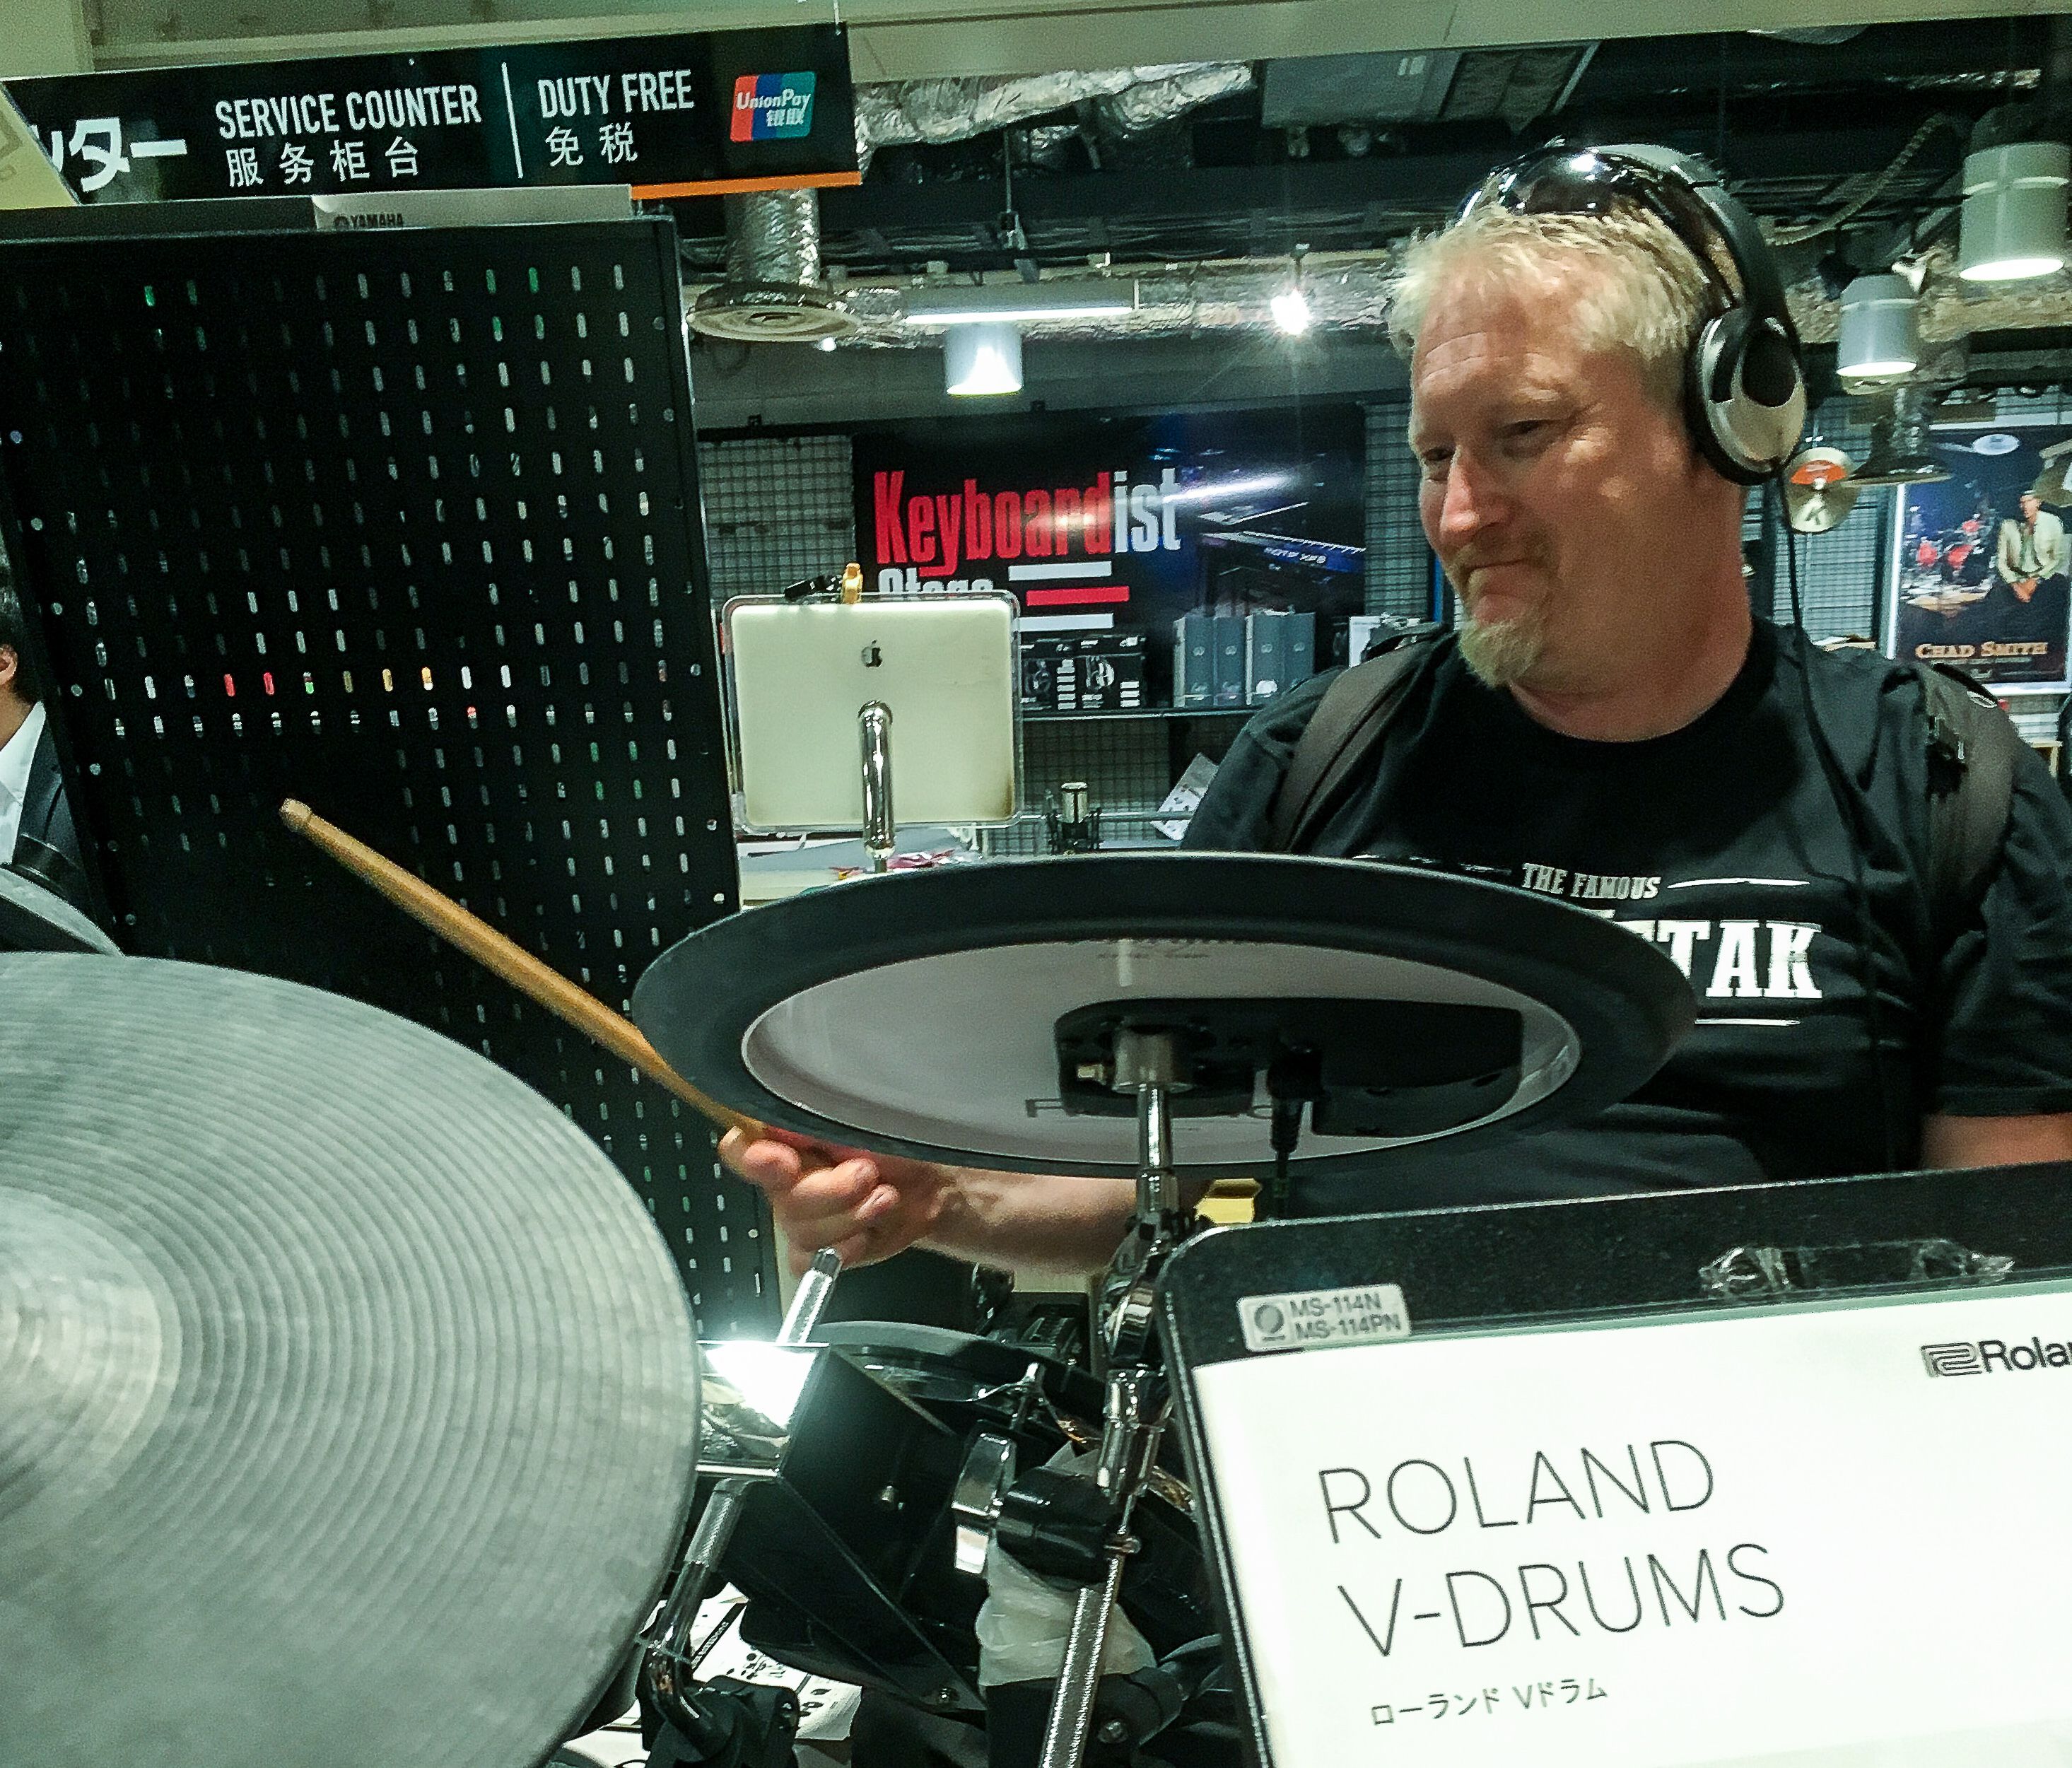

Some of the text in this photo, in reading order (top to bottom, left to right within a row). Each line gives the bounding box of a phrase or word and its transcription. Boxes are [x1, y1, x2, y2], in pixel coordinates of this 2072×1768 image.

[215, 84, 482, 139] SERVICE COUNTER
[537, 69, 695, 119] DUTY FREE
[735, 88, 811, 114] UnionPay
[226, 136, 419, 187] 服务柜台
[545, 122, 638, 167] 免税
[351, 213, 404, 228] YAMAHA
[874, 468, 1182, 577] Keyboardist
[1521, 862, 1661, 900] THE FAMOUS
[1612, 920, 1823, 998] TAK
[1979, 1336, 2072, 1373] Rola
[1318, 1439, 1714, 1543] ROLAND
[1338, 1542, 1785, 1656] V-DRUMS
[1371, 1678, 1608, 1726] ローランド Vドラム
